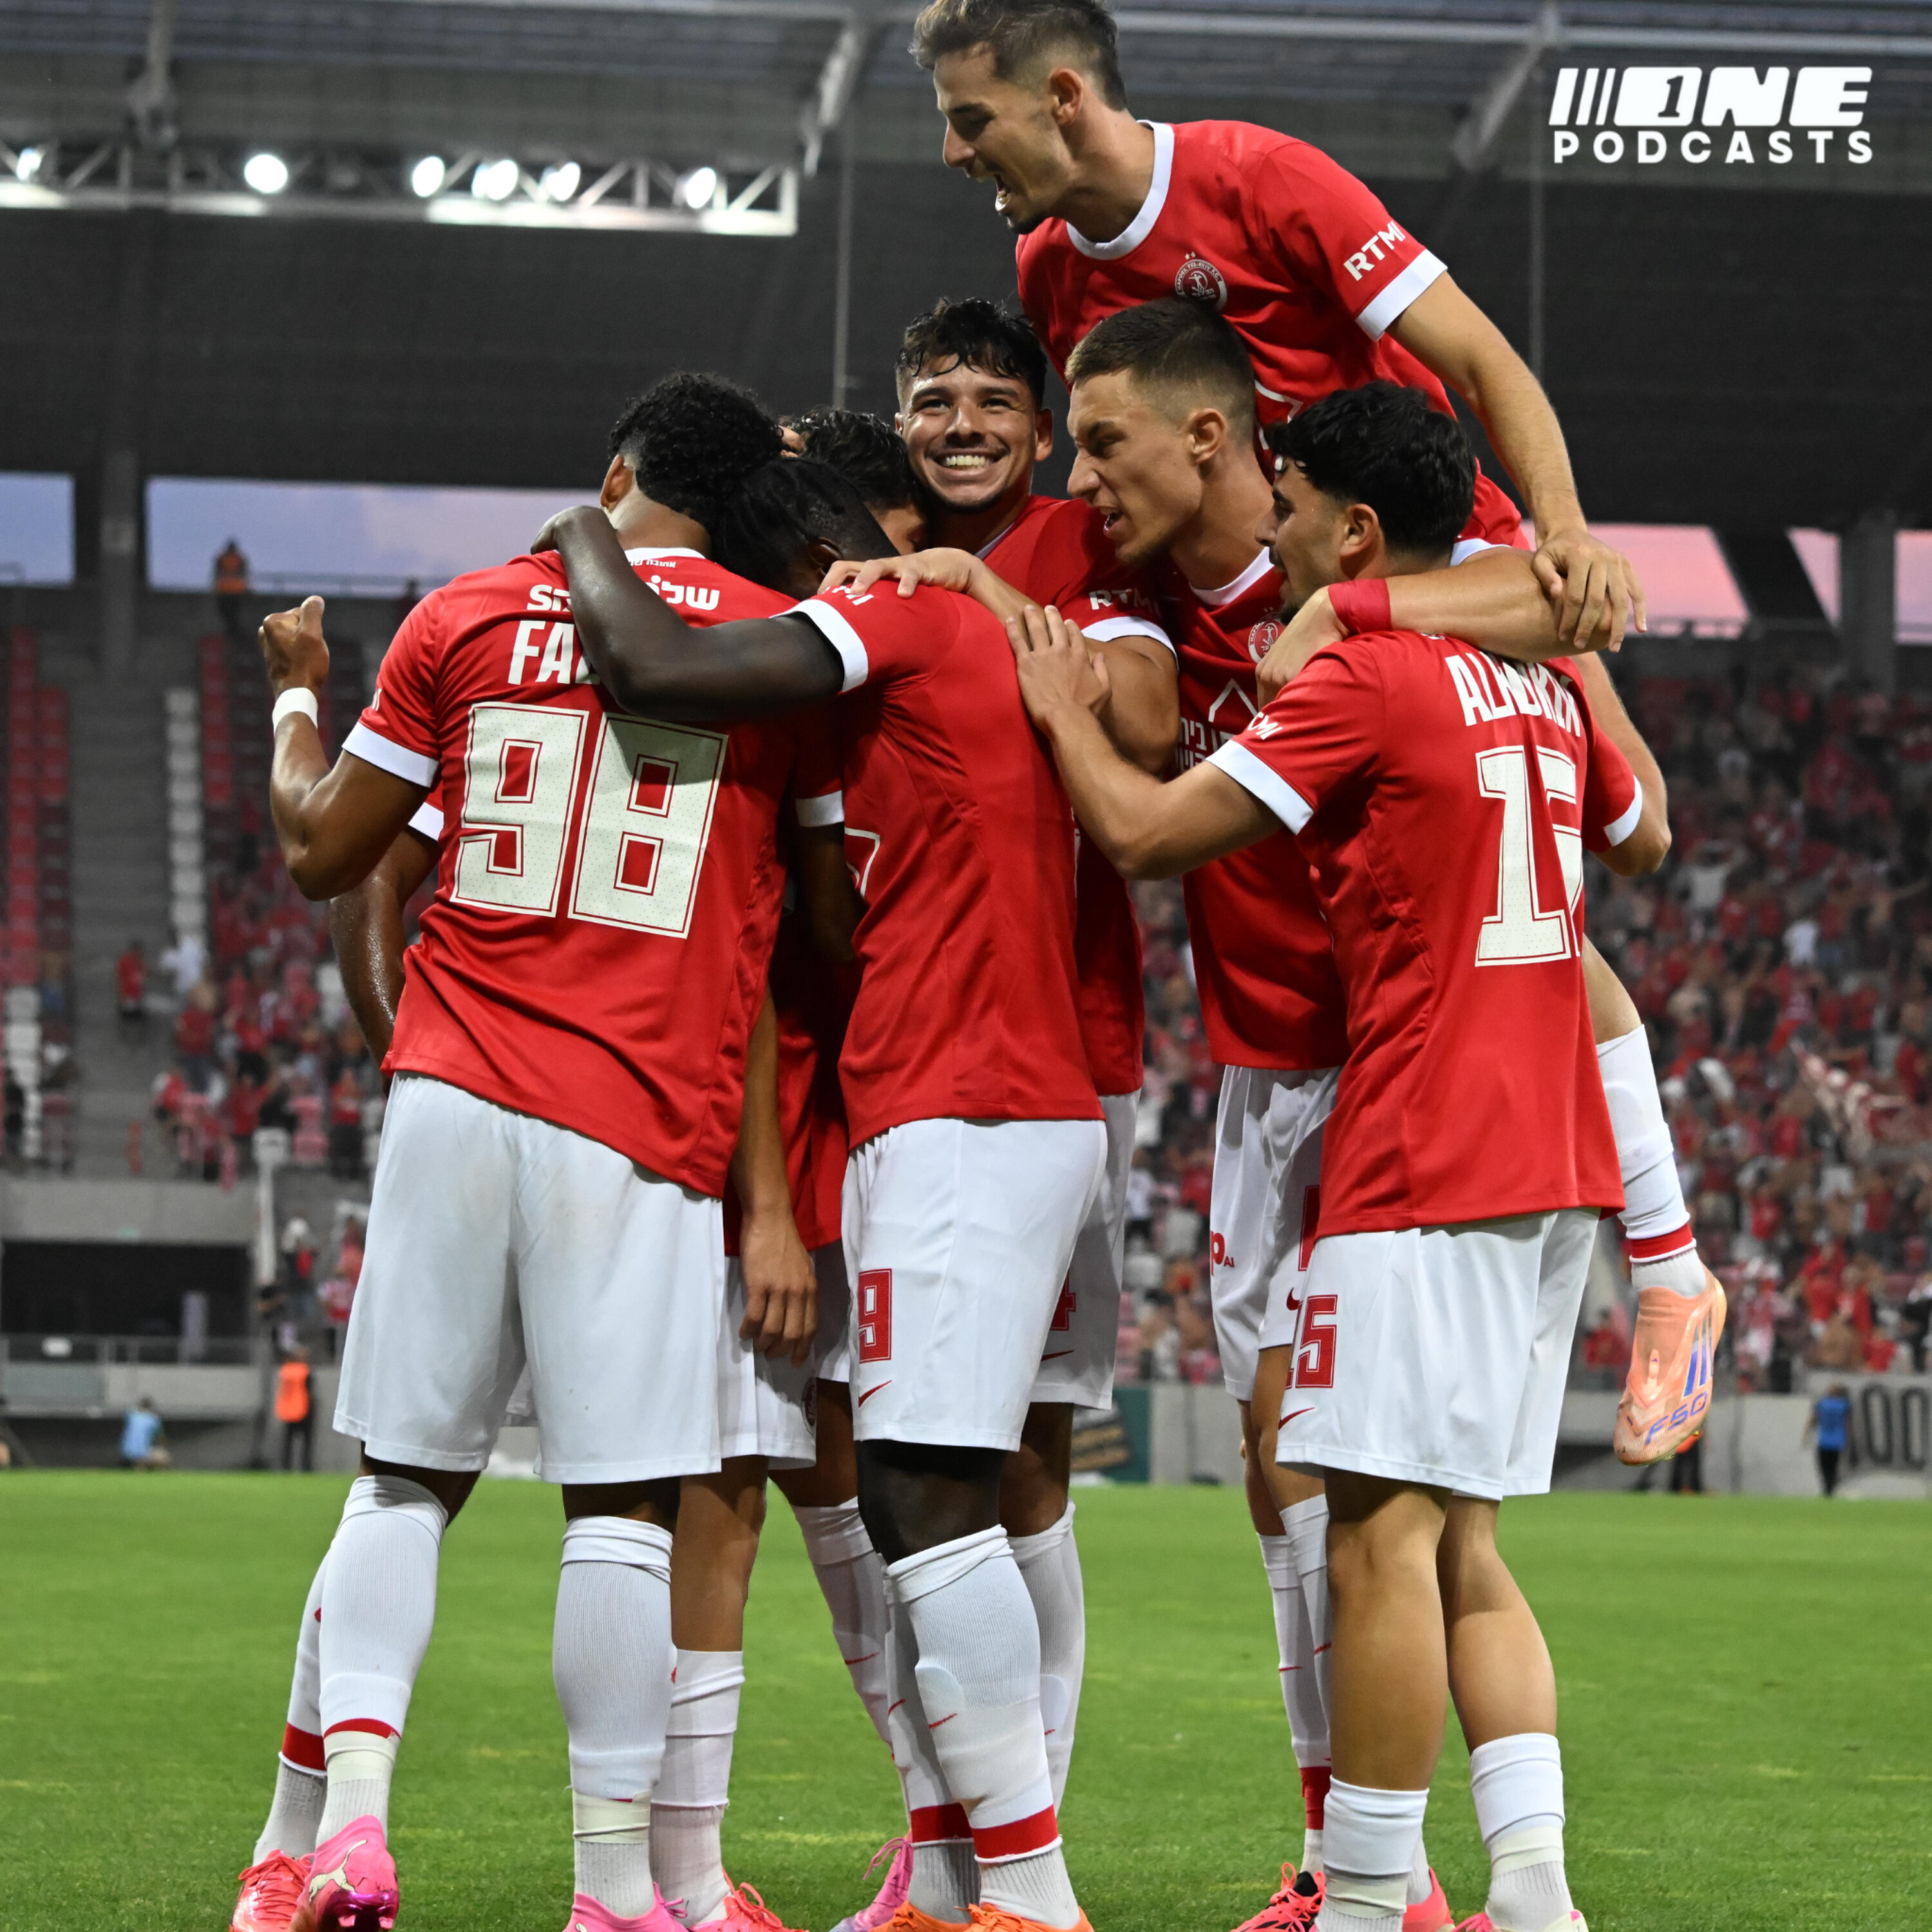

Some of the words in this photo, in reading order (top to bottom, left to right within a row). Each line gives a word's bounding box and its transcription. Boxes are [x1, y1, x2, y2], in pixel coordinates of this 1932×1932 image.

[1343, 220, 1406, 281] RTM
[450, 701, 729, 940] 98
[1474, 744, 1582, 967] 15
[858, 1267, 893, 1365] 9
